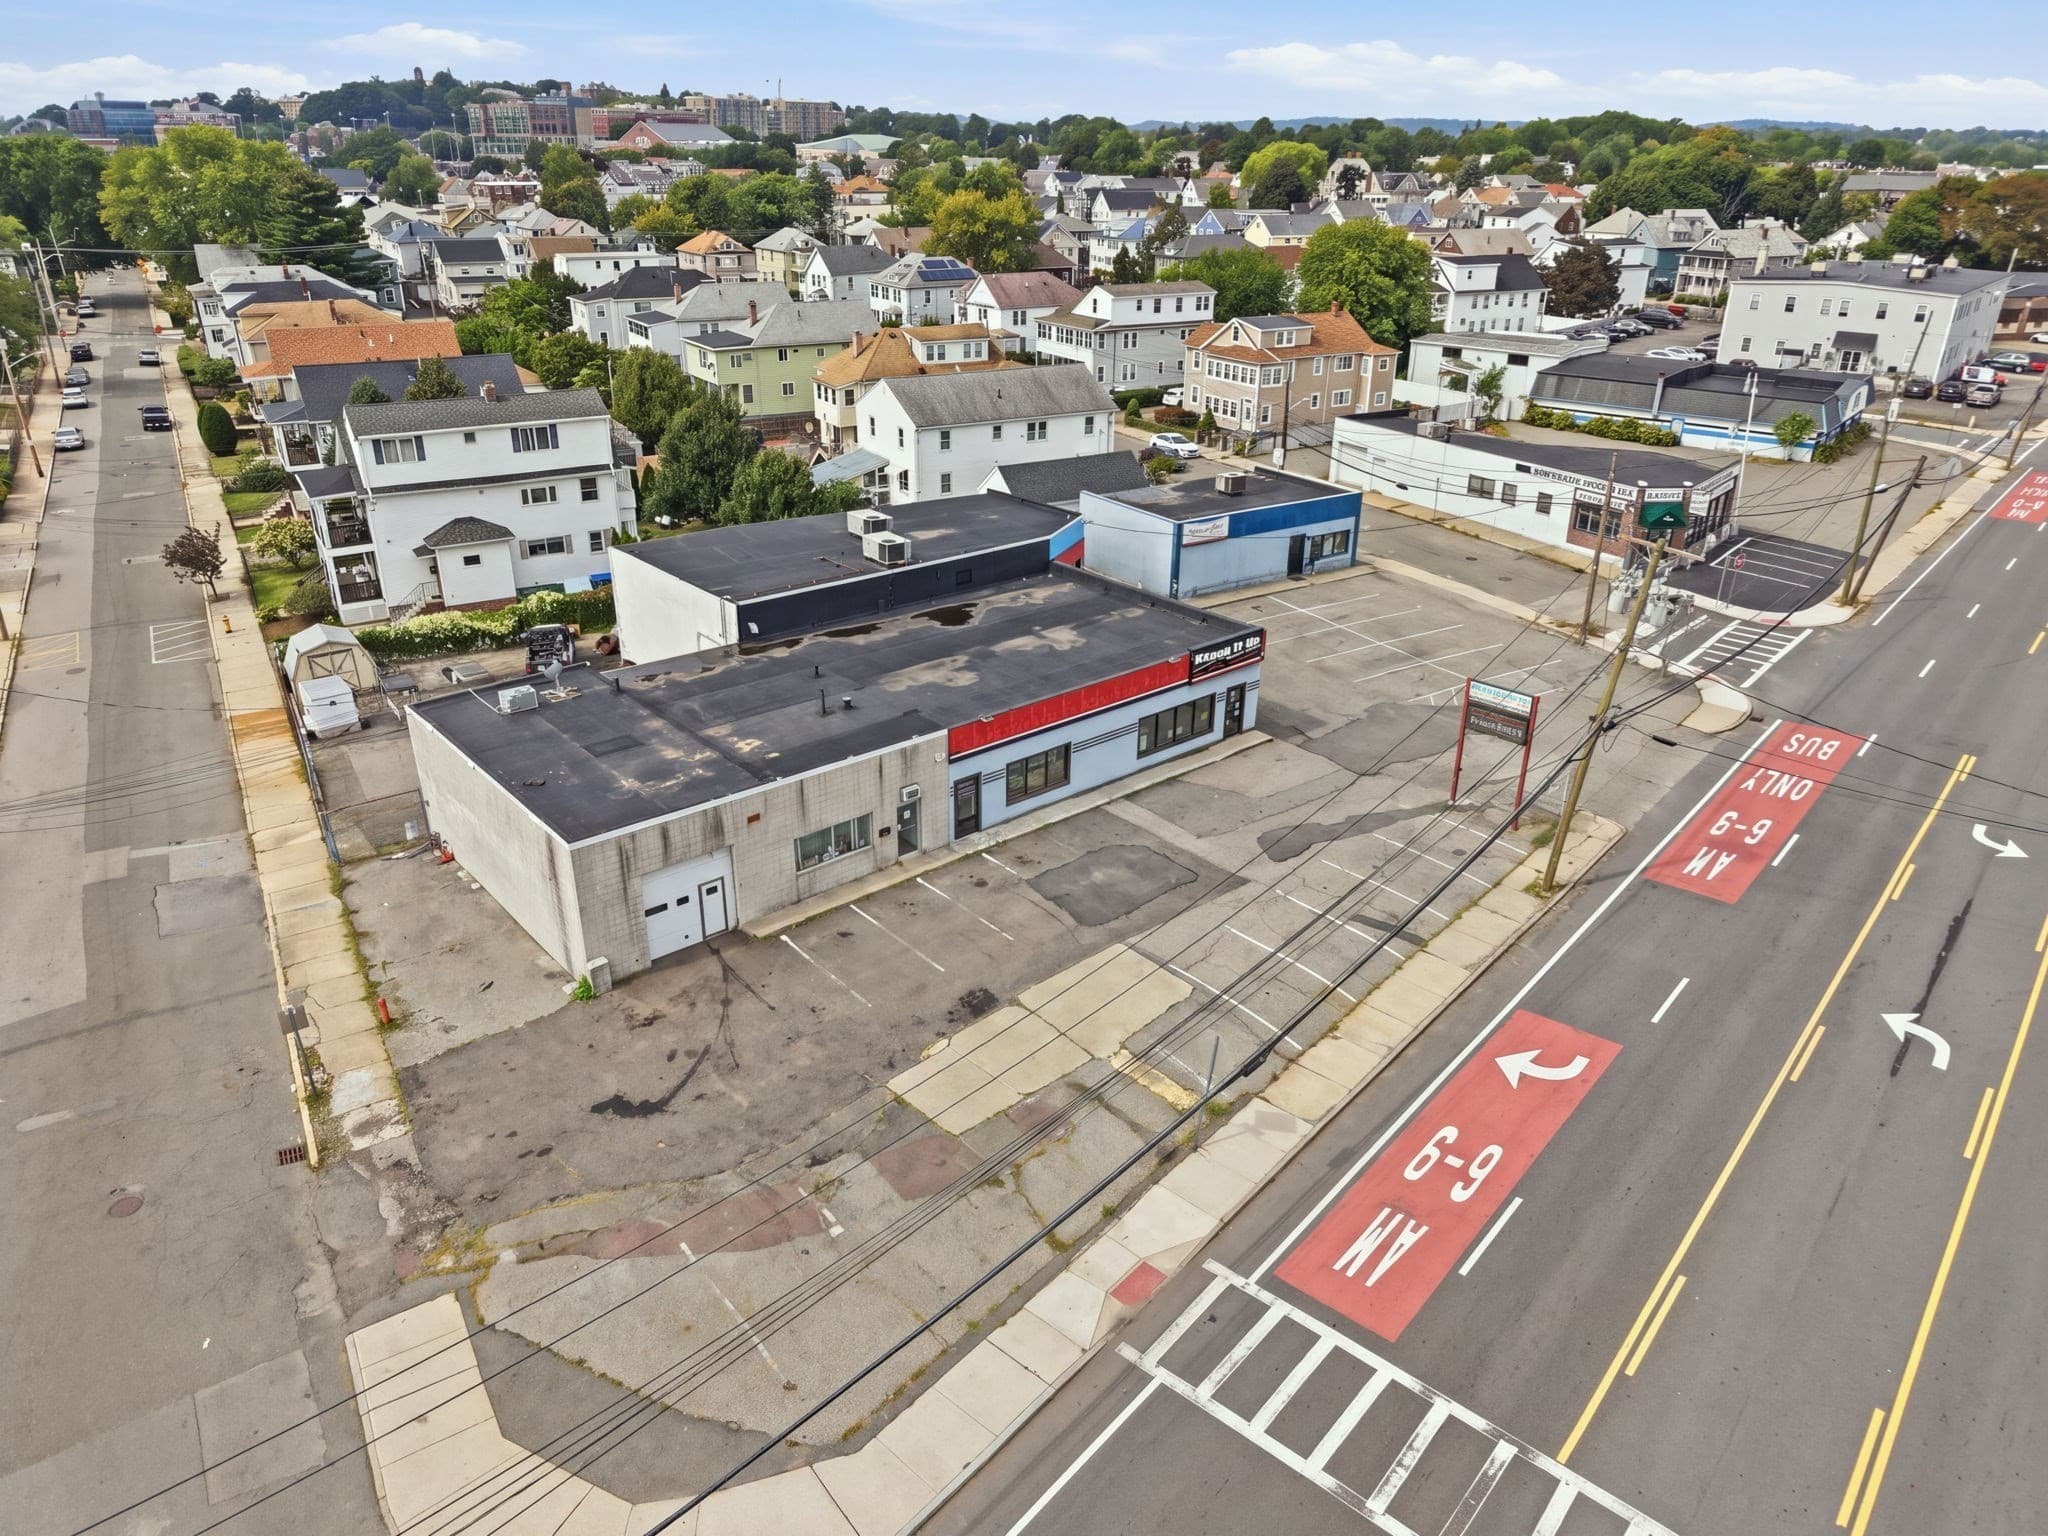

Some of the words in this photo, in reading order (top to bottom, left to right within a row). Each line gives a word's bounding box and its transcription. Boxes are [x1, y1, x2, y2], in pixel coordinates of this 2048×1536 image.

[1783, 733, 1841, 761] BUS
[1740, 768, 1815, 801] ONLY
[1710, 810, 1773, 845] 6-9
[1682, 846, 1737, 881] AM
[1403, 1125, 1503, 1203] 6-9
[1332, 1207, 1430, 1288] AM
